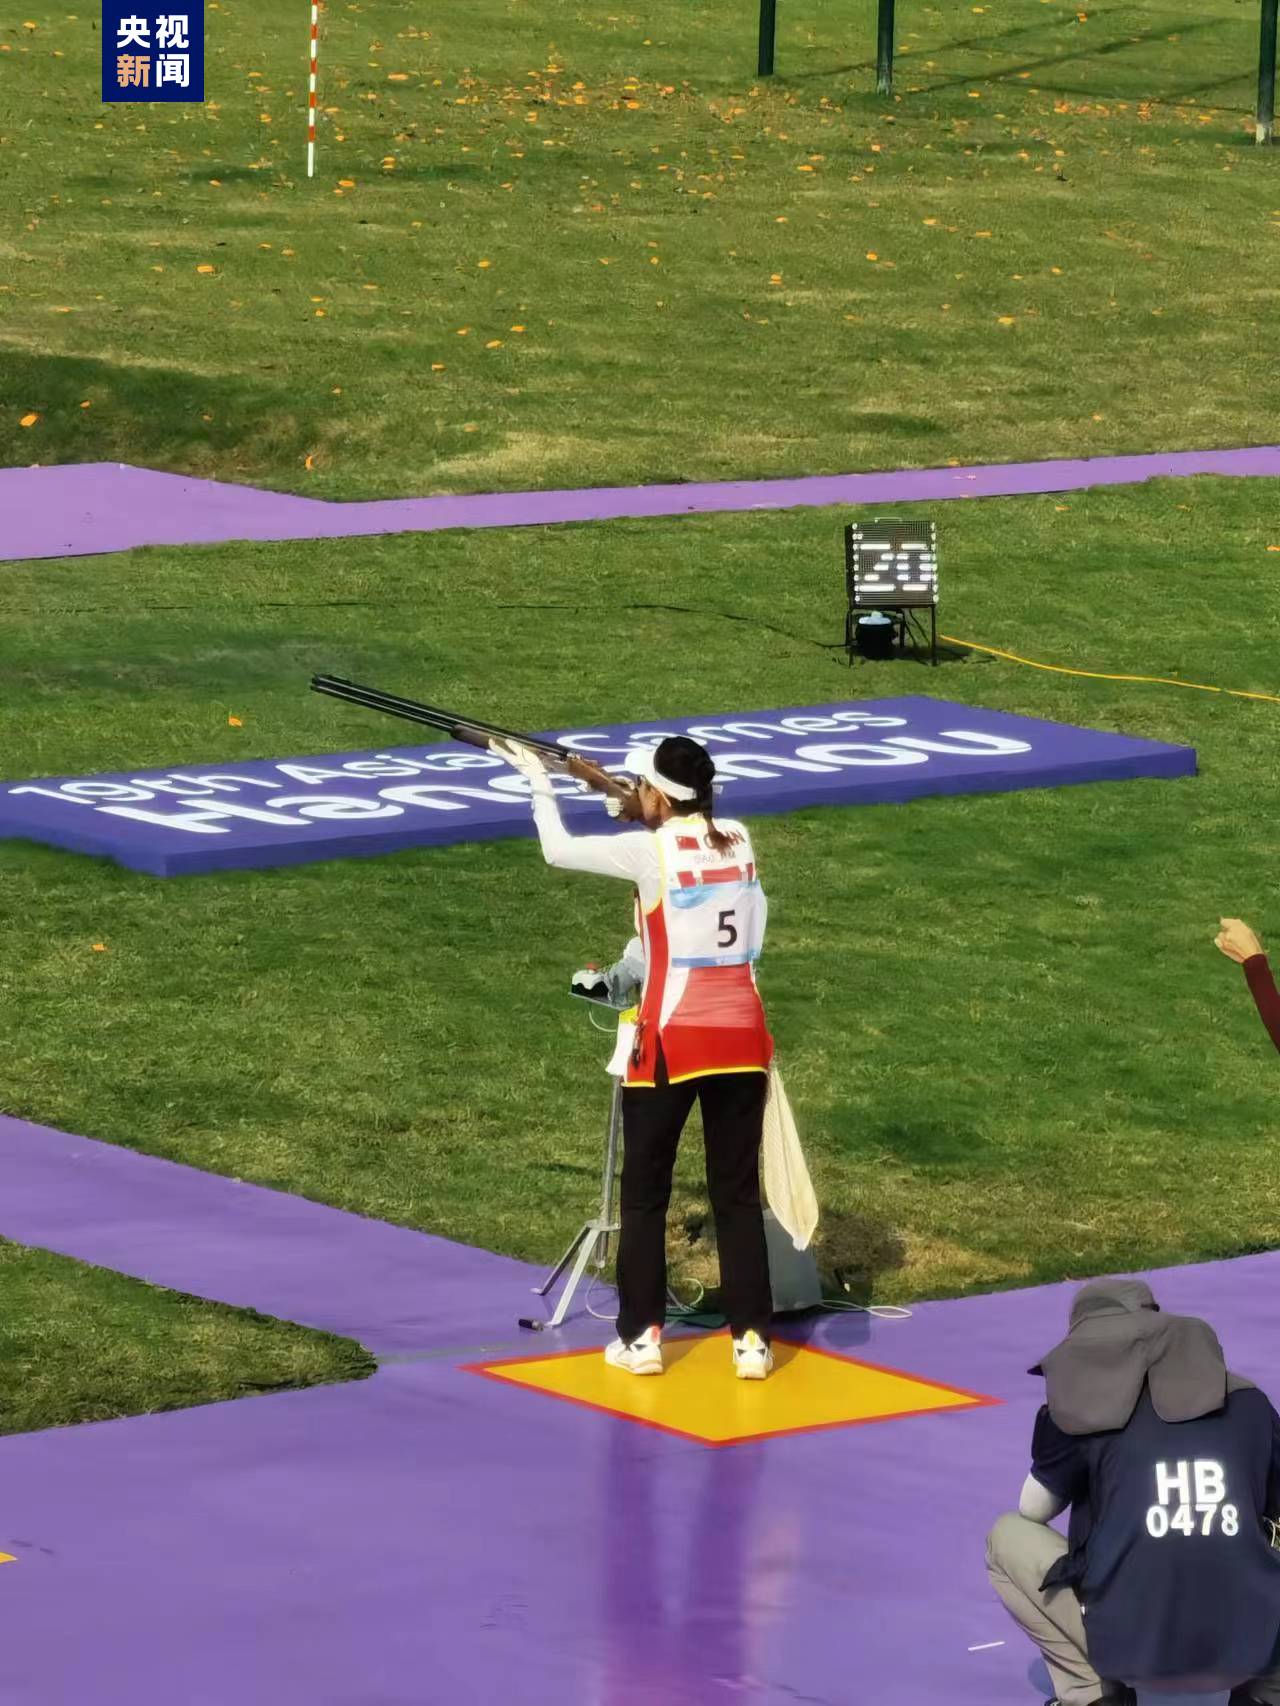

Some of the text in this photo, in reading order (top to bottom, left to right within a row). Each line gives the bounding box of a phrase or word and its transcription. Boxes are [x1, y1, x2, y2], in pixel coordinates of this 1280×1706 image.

[8, 774, 283, 805] 19th
[275, 748, 505, 784] Asia
[717, 909, 738, 948] 5
[1156, 1460, 1226, 1505] HB
[1146, 1503, 1239, 1538] 0478
